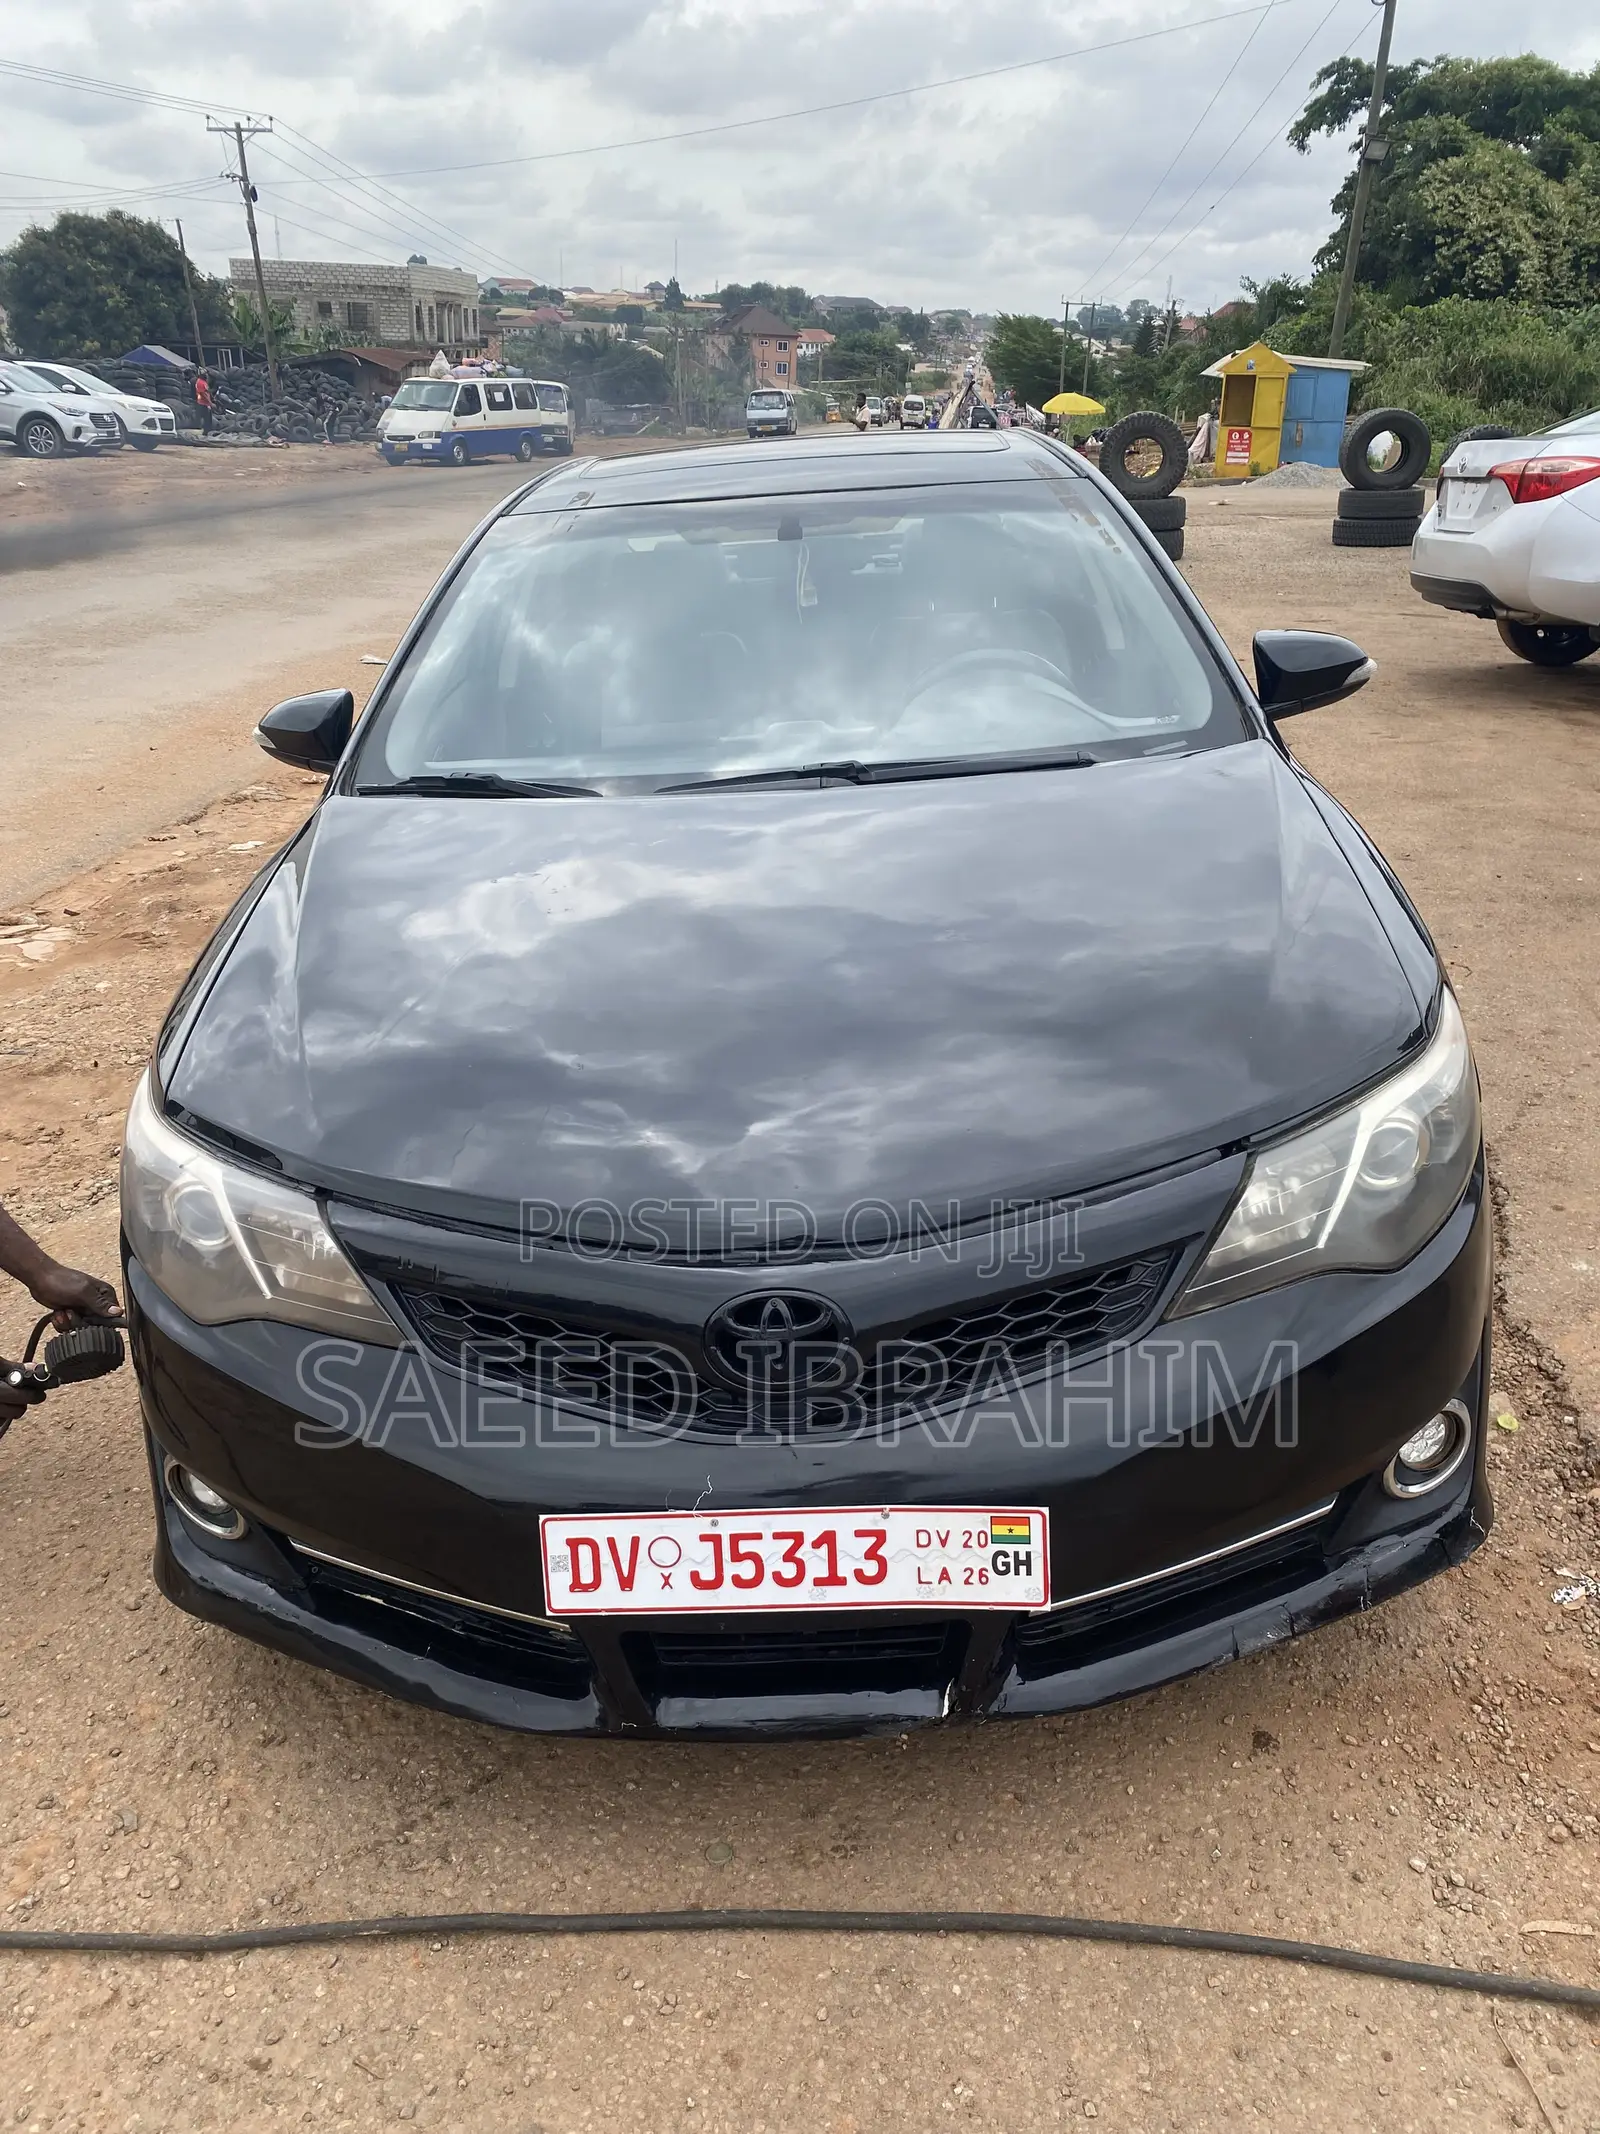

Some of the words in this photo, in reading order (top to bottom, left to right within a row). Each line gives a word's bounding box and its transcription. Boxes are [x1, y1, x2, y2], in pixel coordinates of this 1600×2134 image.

[915, 1528, 951, 1549] DV
[961, 1529, 989, 1549] 20
[565, 1535, 641, 1593] DV
[689, 1528, 888, 1591] J5313
[991, 1549, 1033, 1577] GH
[917, 1565, 953, 1586] LA
[963, 1566, 990, 1586] 26
